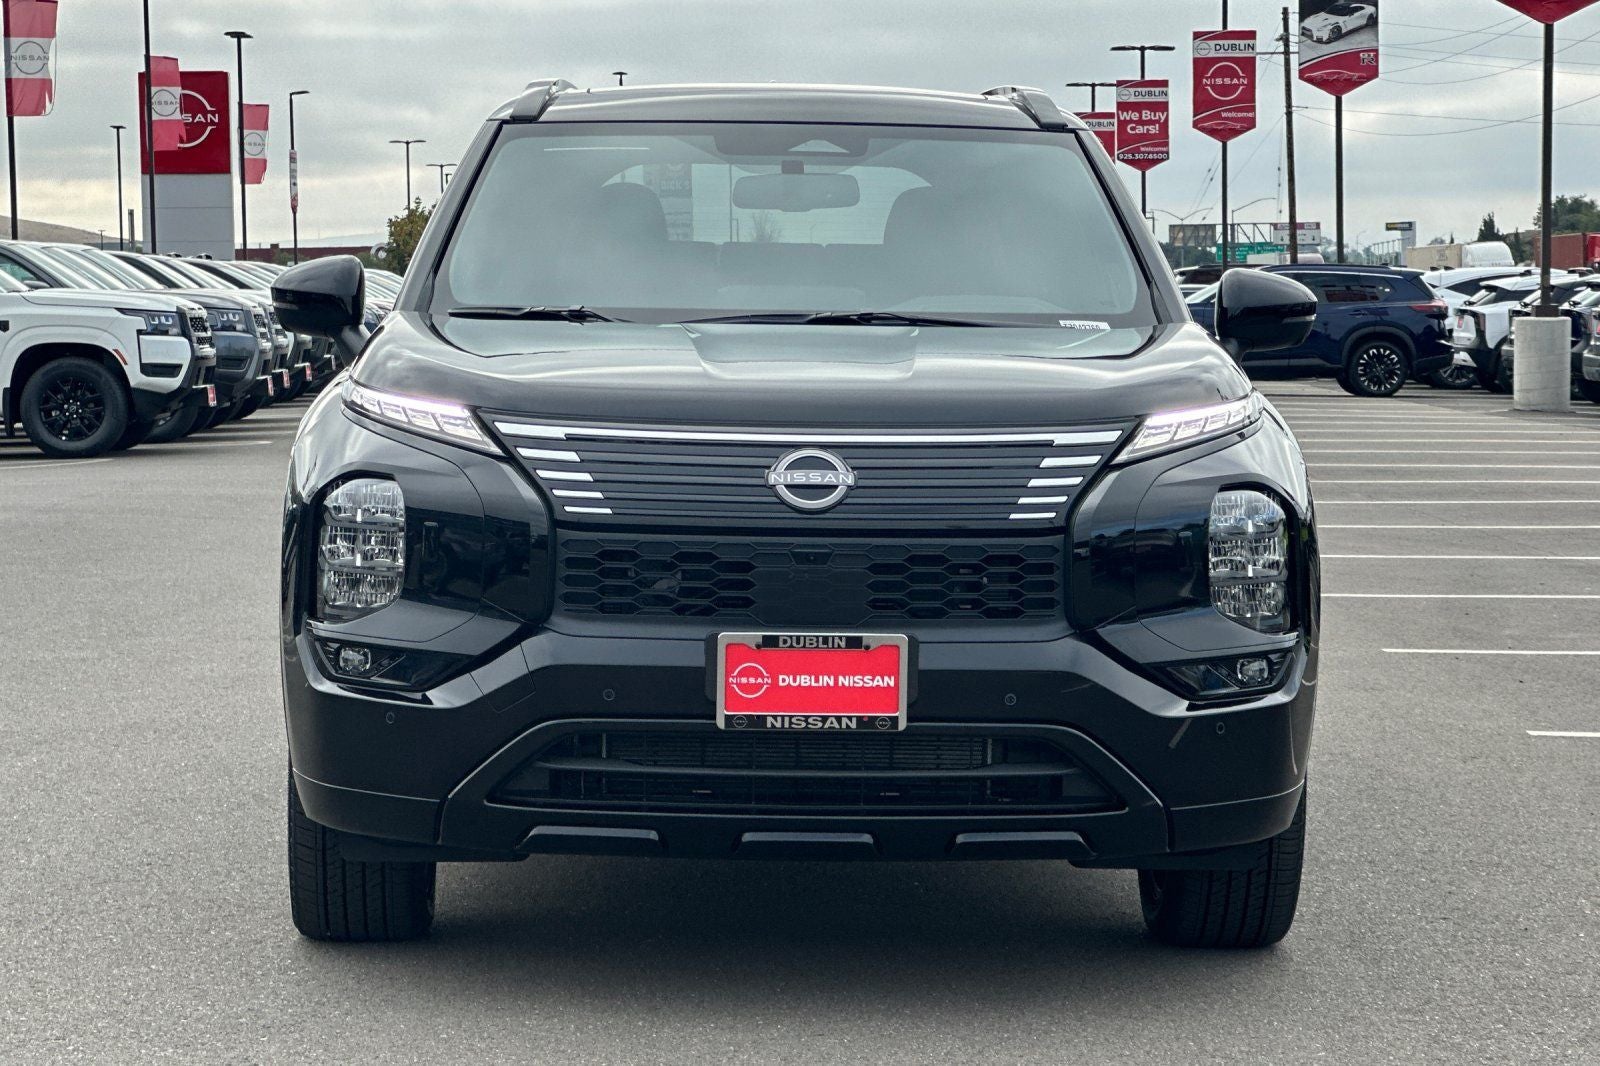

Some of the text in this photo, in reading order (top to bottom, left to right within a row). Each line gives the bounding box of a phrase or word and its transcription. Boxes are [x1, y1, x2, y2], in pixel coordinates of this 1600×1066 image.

[1214, 43, 1255, 51] DUBLIN
[1202, 77, 1248, 85] NISSAN
[1118, 110, 1167, 123] We Buy
[1127, 124, 1159, 134] Cars!
[771, 472, 852, 484] NISSAN
[778, 636, 846, 648] DUBLIN
[778, 674, 895, 687] DUBLIN NISSAN
[766, 716, 857, 729] NISSAN
